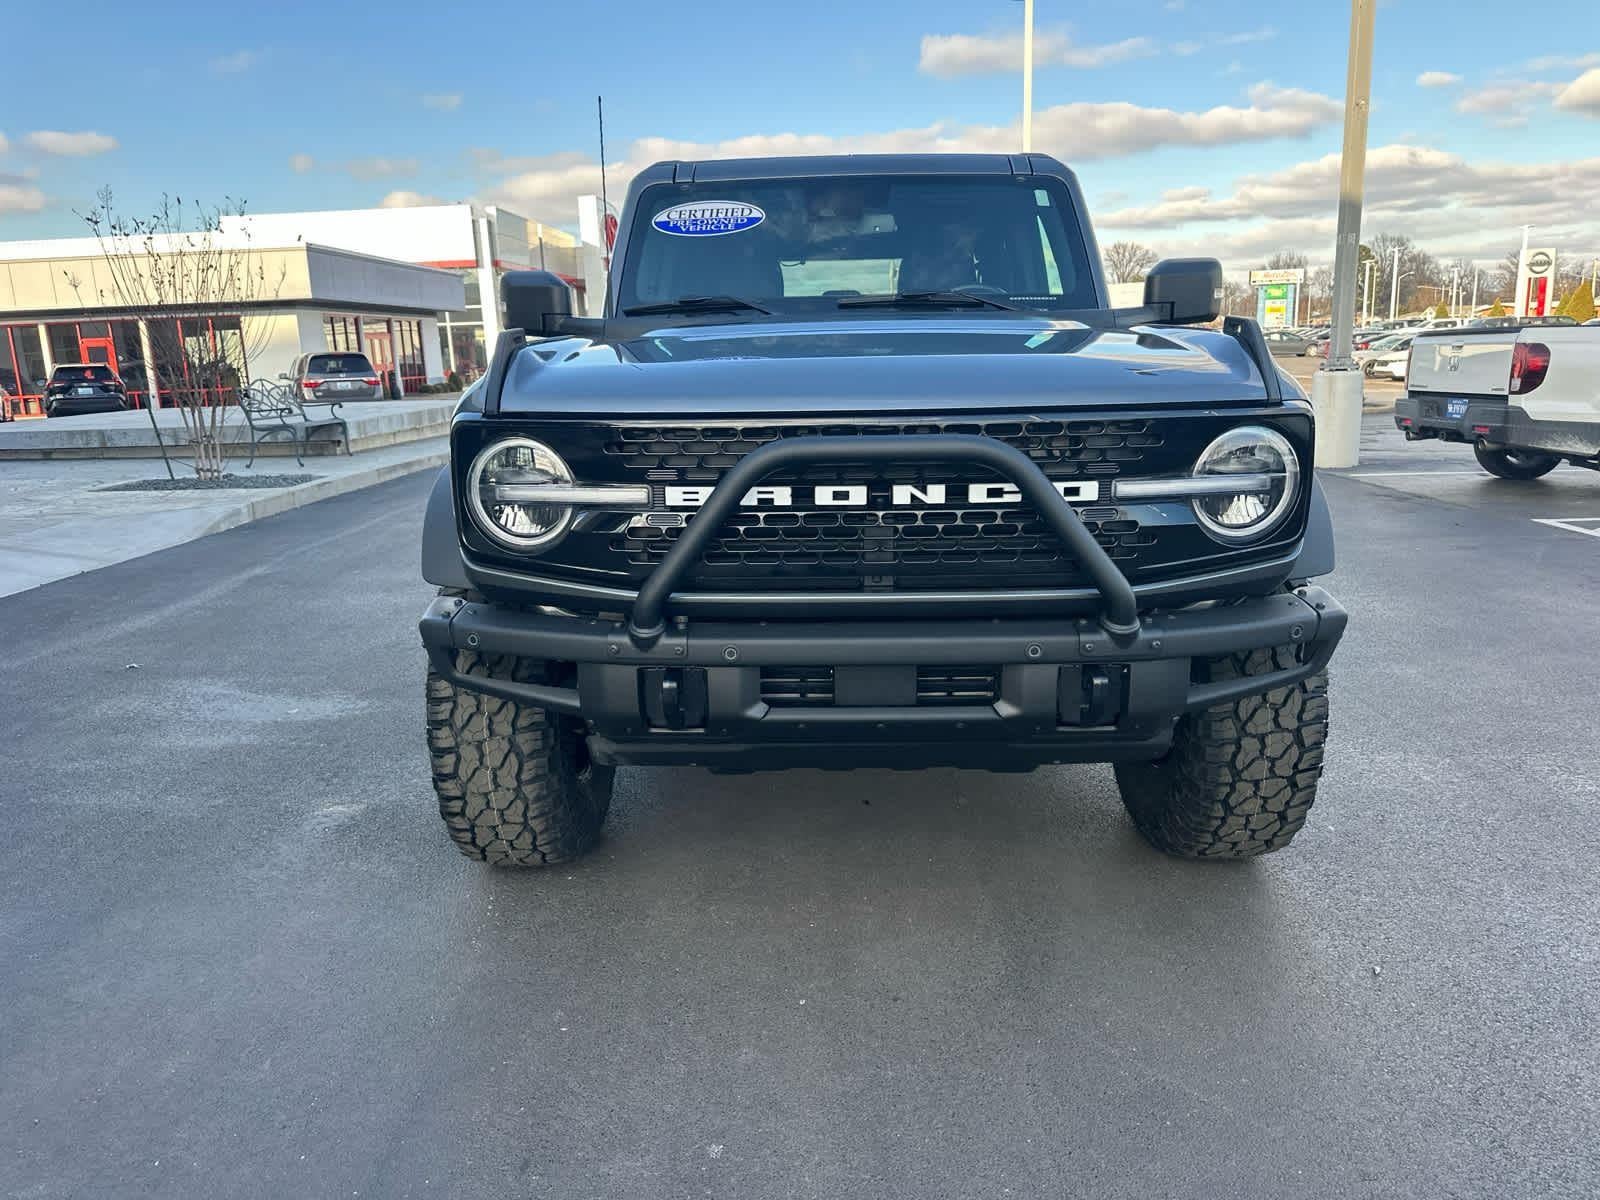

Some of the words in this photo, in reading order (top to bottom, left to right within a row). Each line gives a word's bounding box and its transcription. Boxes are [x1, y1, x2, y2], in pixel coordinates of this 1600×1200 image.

[666, 207, 753, 220] CERTIFIED
[669, 217, 748, 227] PRE-OWNED
[680, 223, 736, 232] VEHICLE
[664, 480, 1099, 506] BRONCO
